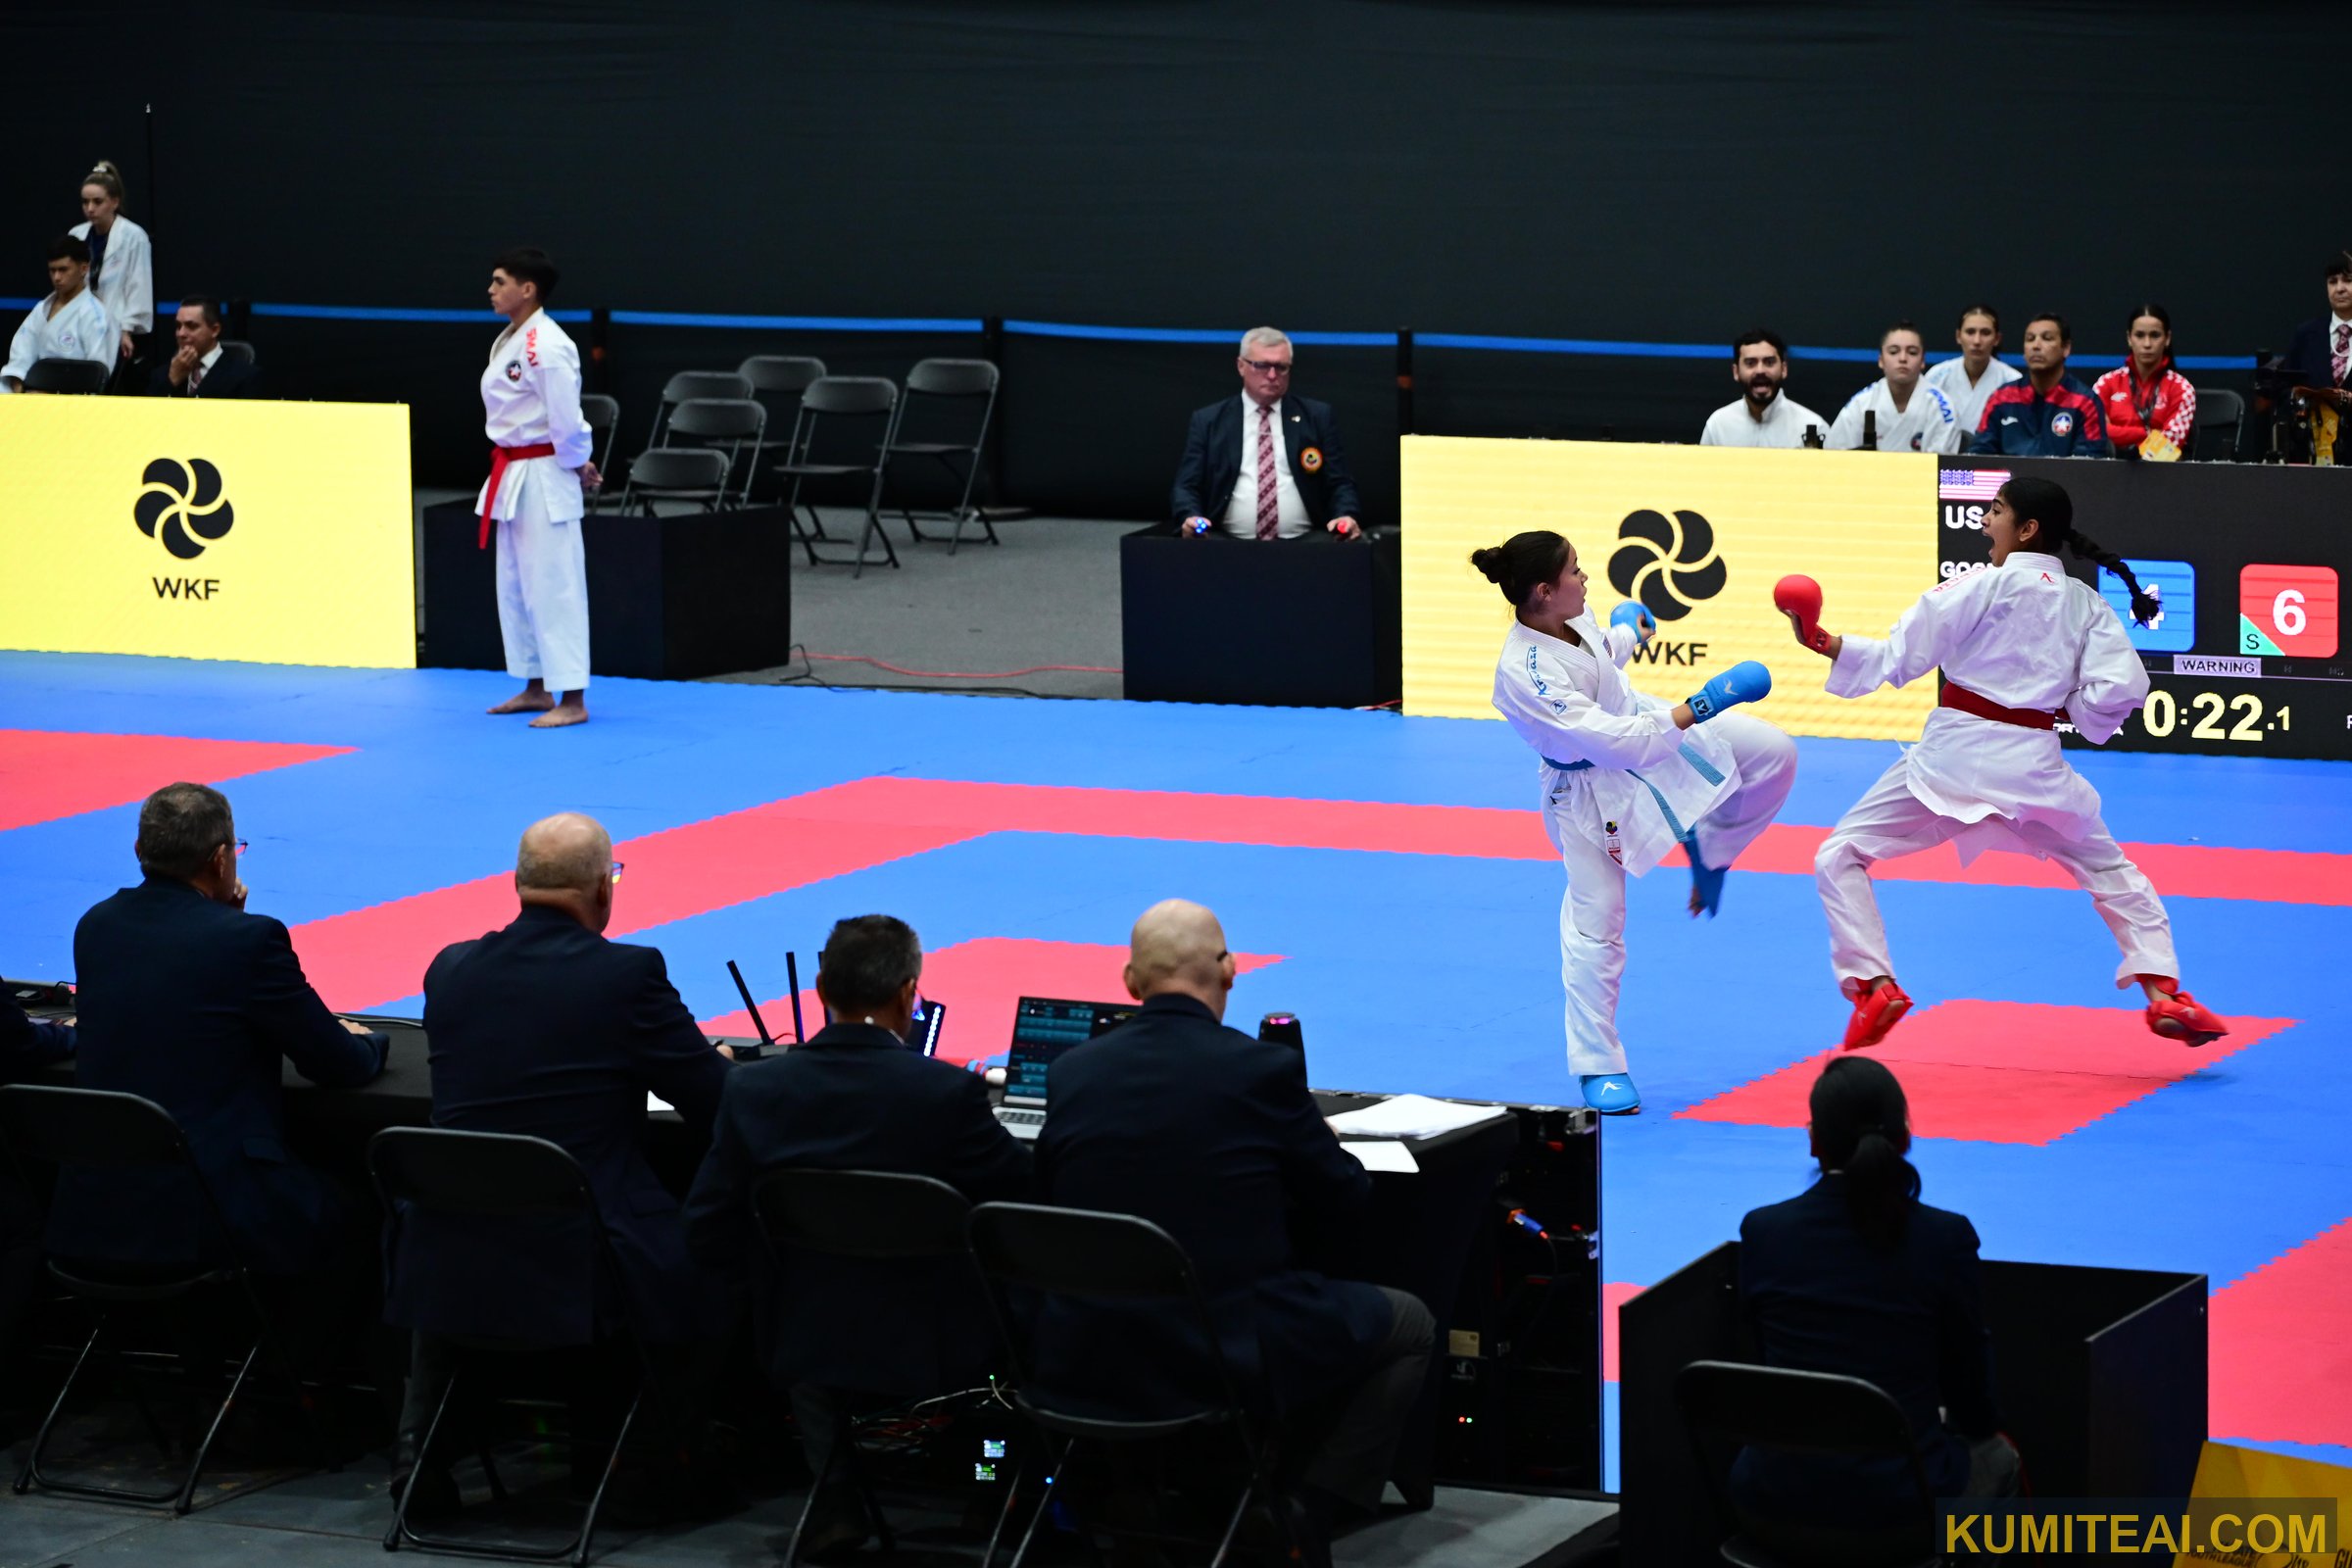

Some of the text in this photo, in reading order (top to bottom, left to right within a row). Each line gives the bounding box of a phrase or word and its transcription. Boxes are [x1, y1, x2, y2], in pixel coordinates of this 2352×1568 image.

[1945, 505, 1983, 530] US
[152, 576, 220, 601] WKF
[2273, 588, 2307, 636] 6
[1632, 641, 1708, 666] WKF
[2245, 633, 2260, 650] S
[2180, 659, 2256, 674] WARNING
